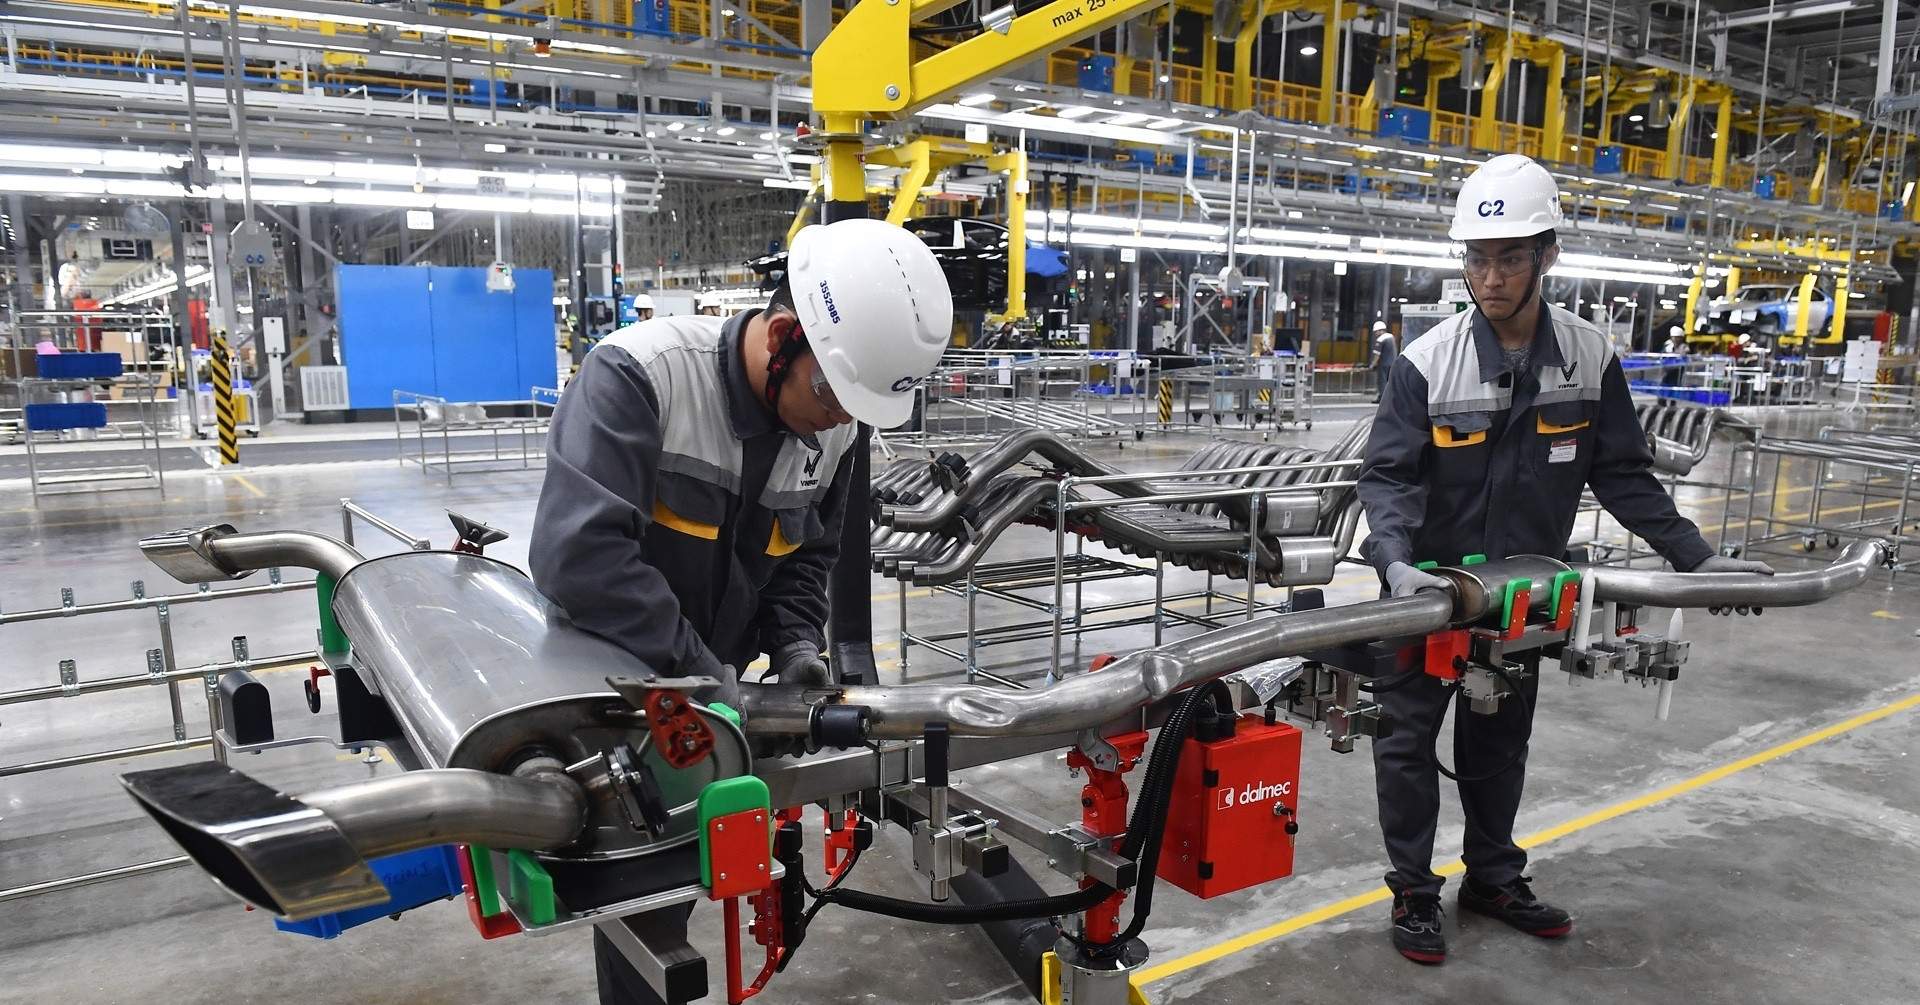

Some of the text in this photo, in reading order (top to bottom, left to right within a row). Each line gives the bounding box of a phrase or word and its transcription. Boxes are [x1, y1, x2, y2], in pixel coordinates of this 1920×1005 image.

[1052, 0, 1105, 27] max 25
[1478, 199, 1505, 218] C2
[819, 280, 841, 325] 3552985
[1239, 780, 1291, 805] dalmec
